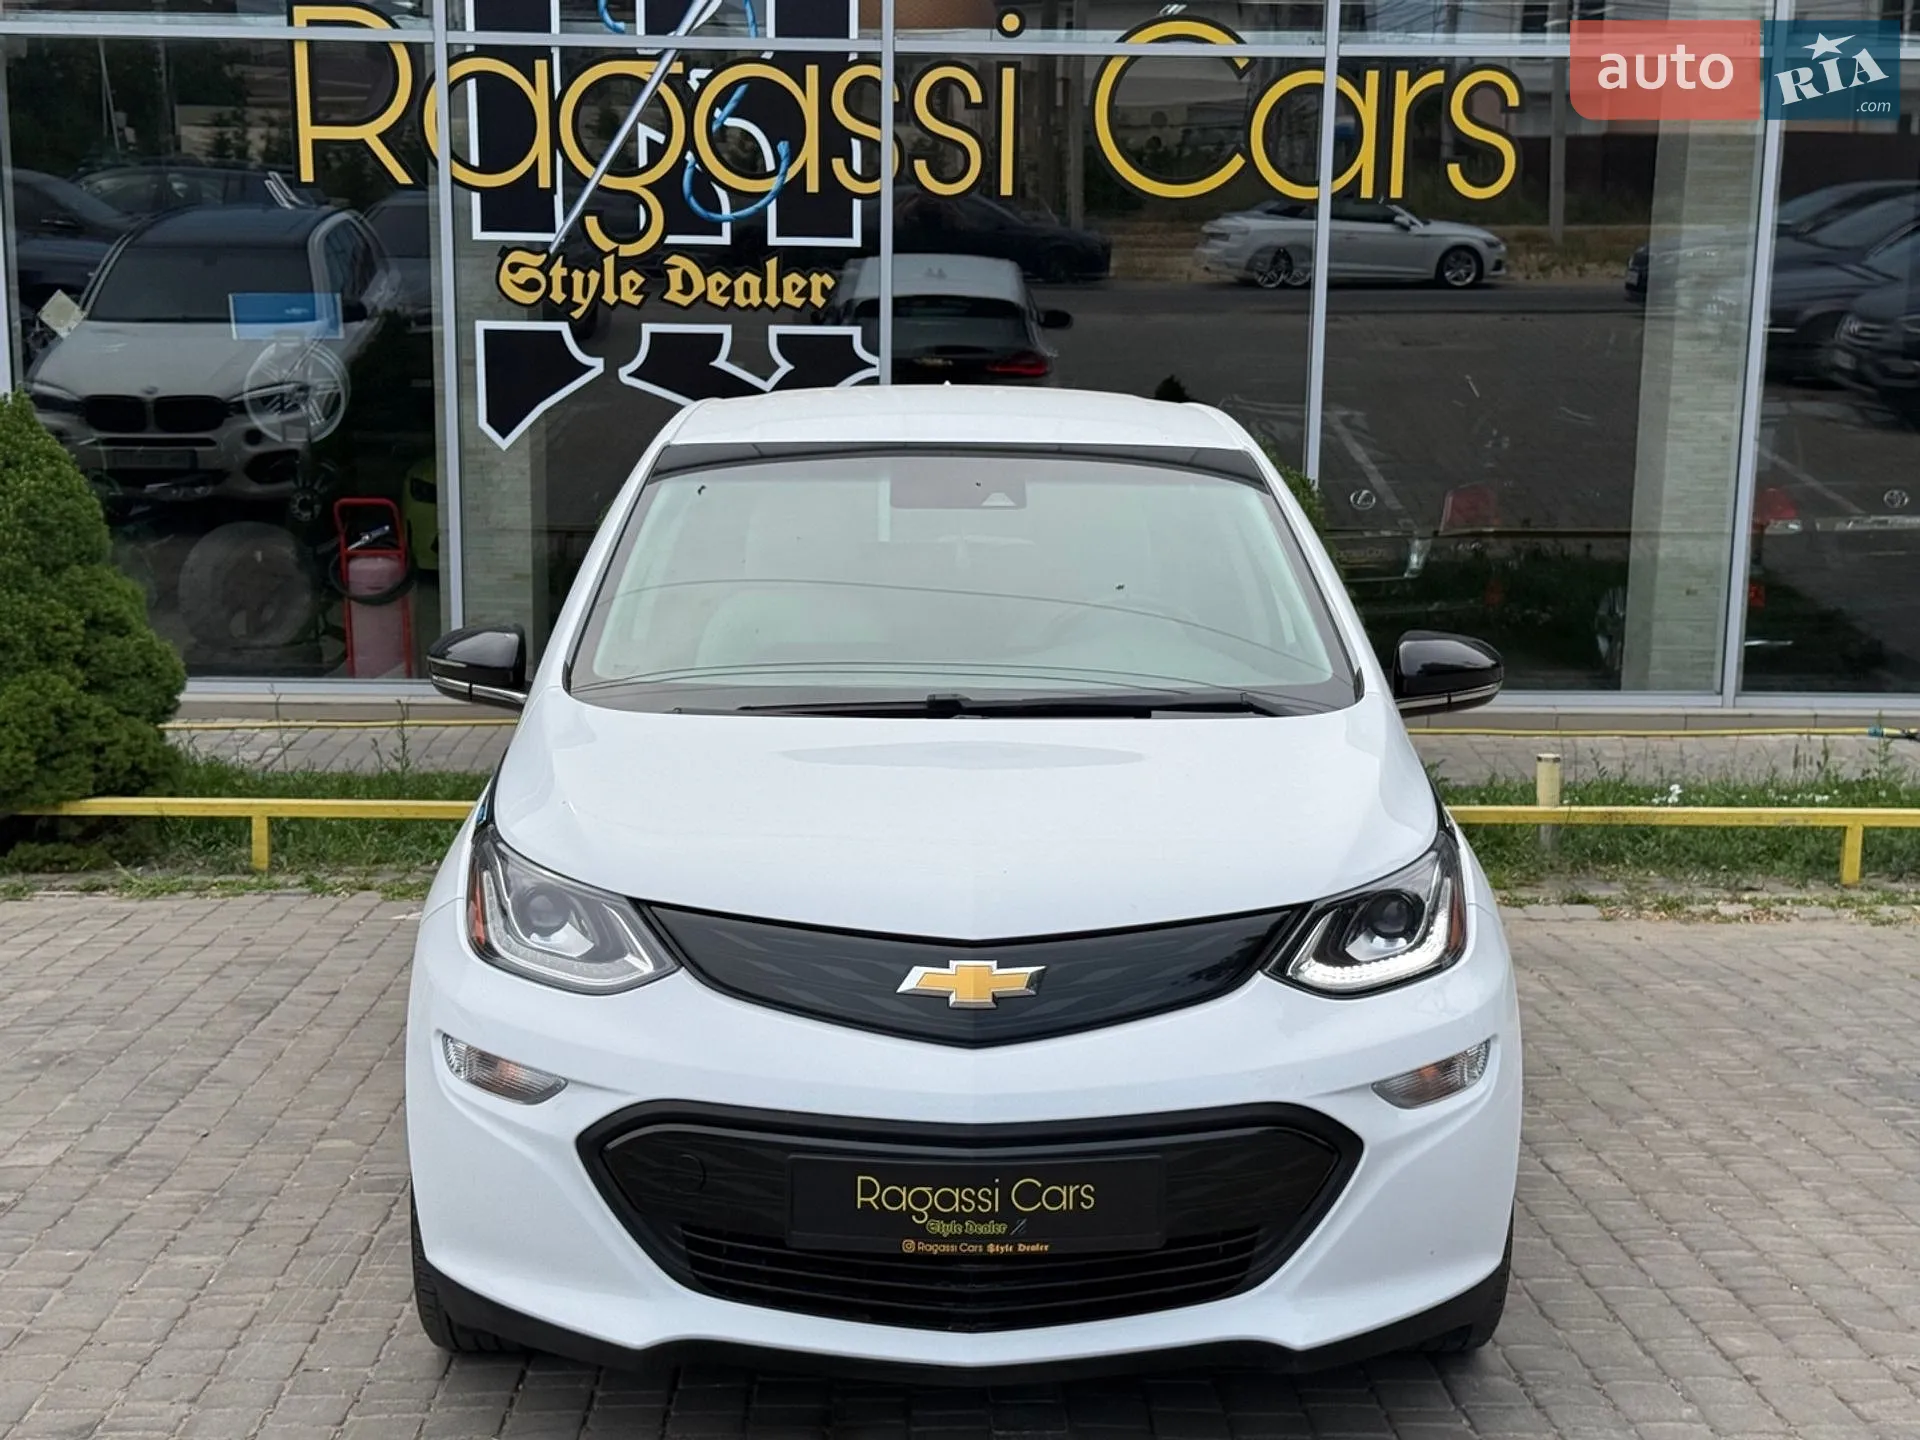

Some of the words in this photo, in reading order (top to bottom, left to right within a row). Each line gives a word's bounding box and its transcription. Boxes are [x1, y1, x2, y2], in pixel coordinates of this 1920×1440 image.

[292, 5, 1015, 257] Ragassi
[1093, 20, 1522, 200] Cars
[498, 249, 646, 318] Style
[662, 255, 836, 310] Dealer
[856, 1175, 1000, 1224] Ragassi
[1010, 1178, 1096, 1212] Cars
[917, 1240, 958, 1255] Ragassi
[958, 1242, 983, 1253] Cars
[986, 1243, 1014, 1254] Style
[1017, 1243, 1050, 1253] Dealer
[926, 1218, 963, 1237] Style
[963, 1218, 1008, 1235] Dealer
